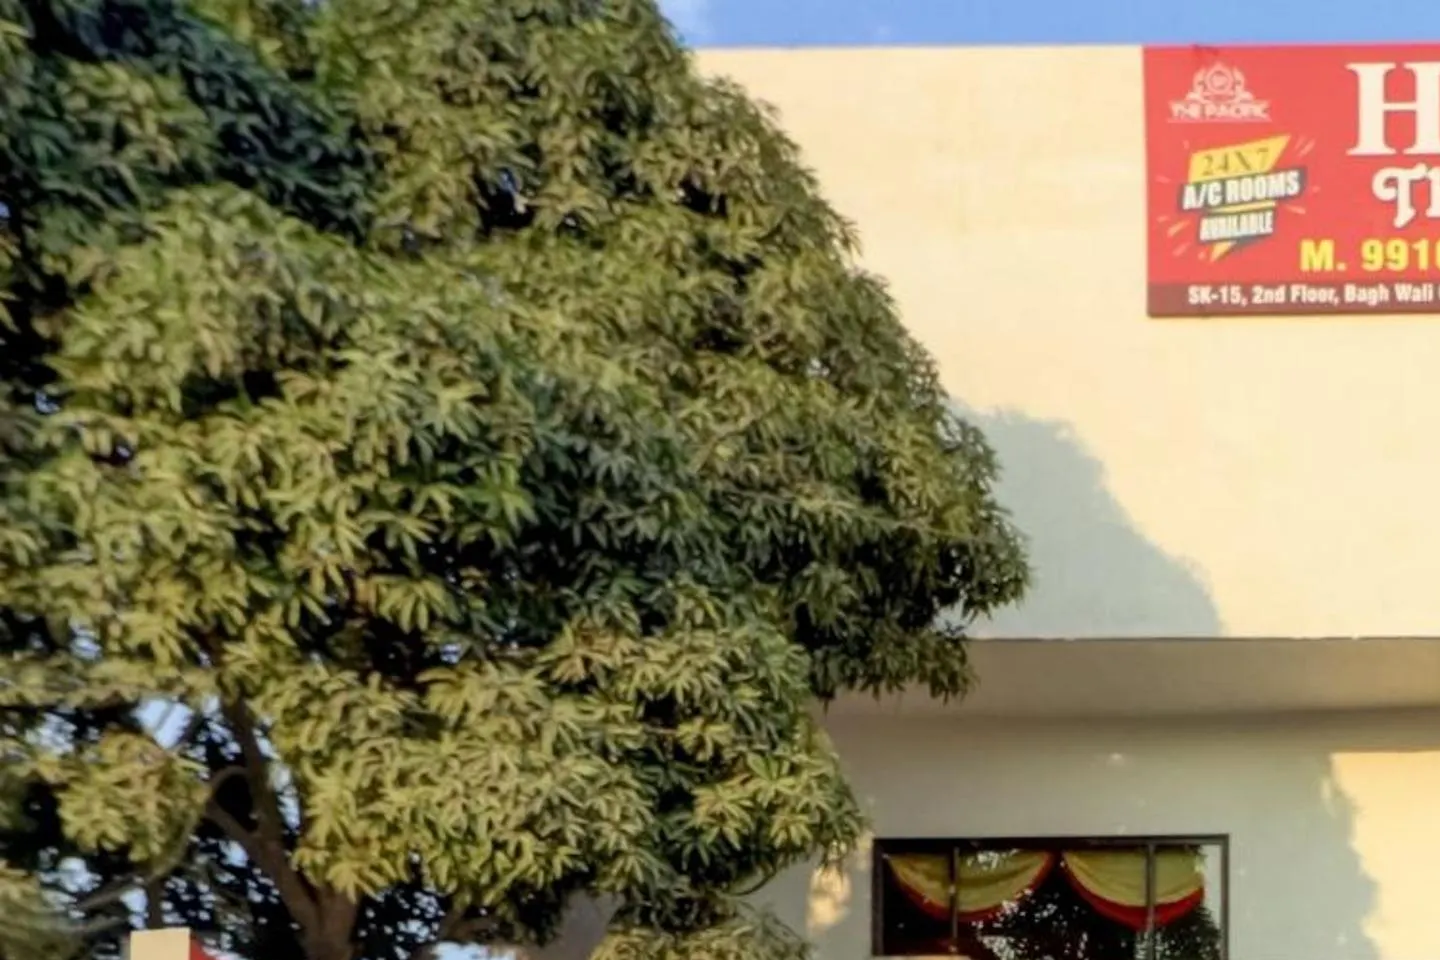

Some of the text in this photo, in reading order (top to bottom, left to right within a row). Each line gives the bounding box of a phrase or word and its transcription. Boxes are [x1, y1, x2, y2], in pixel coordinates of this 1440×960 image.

[1183, 170, 1300, 210] A/C ROOMS
[1199, 211, 1273, 241] AVAILABLE
[1300, 238, 1347, 272] M.
[1188, 285, 1247, 306] SK-15,
[1252, 286, 1284, 303] 2nd
[1290, 285, 1340, 306] Floor,
[1344, 284, 1389, 306] Bagh
[1394, 284, 1433, 301] Wali
